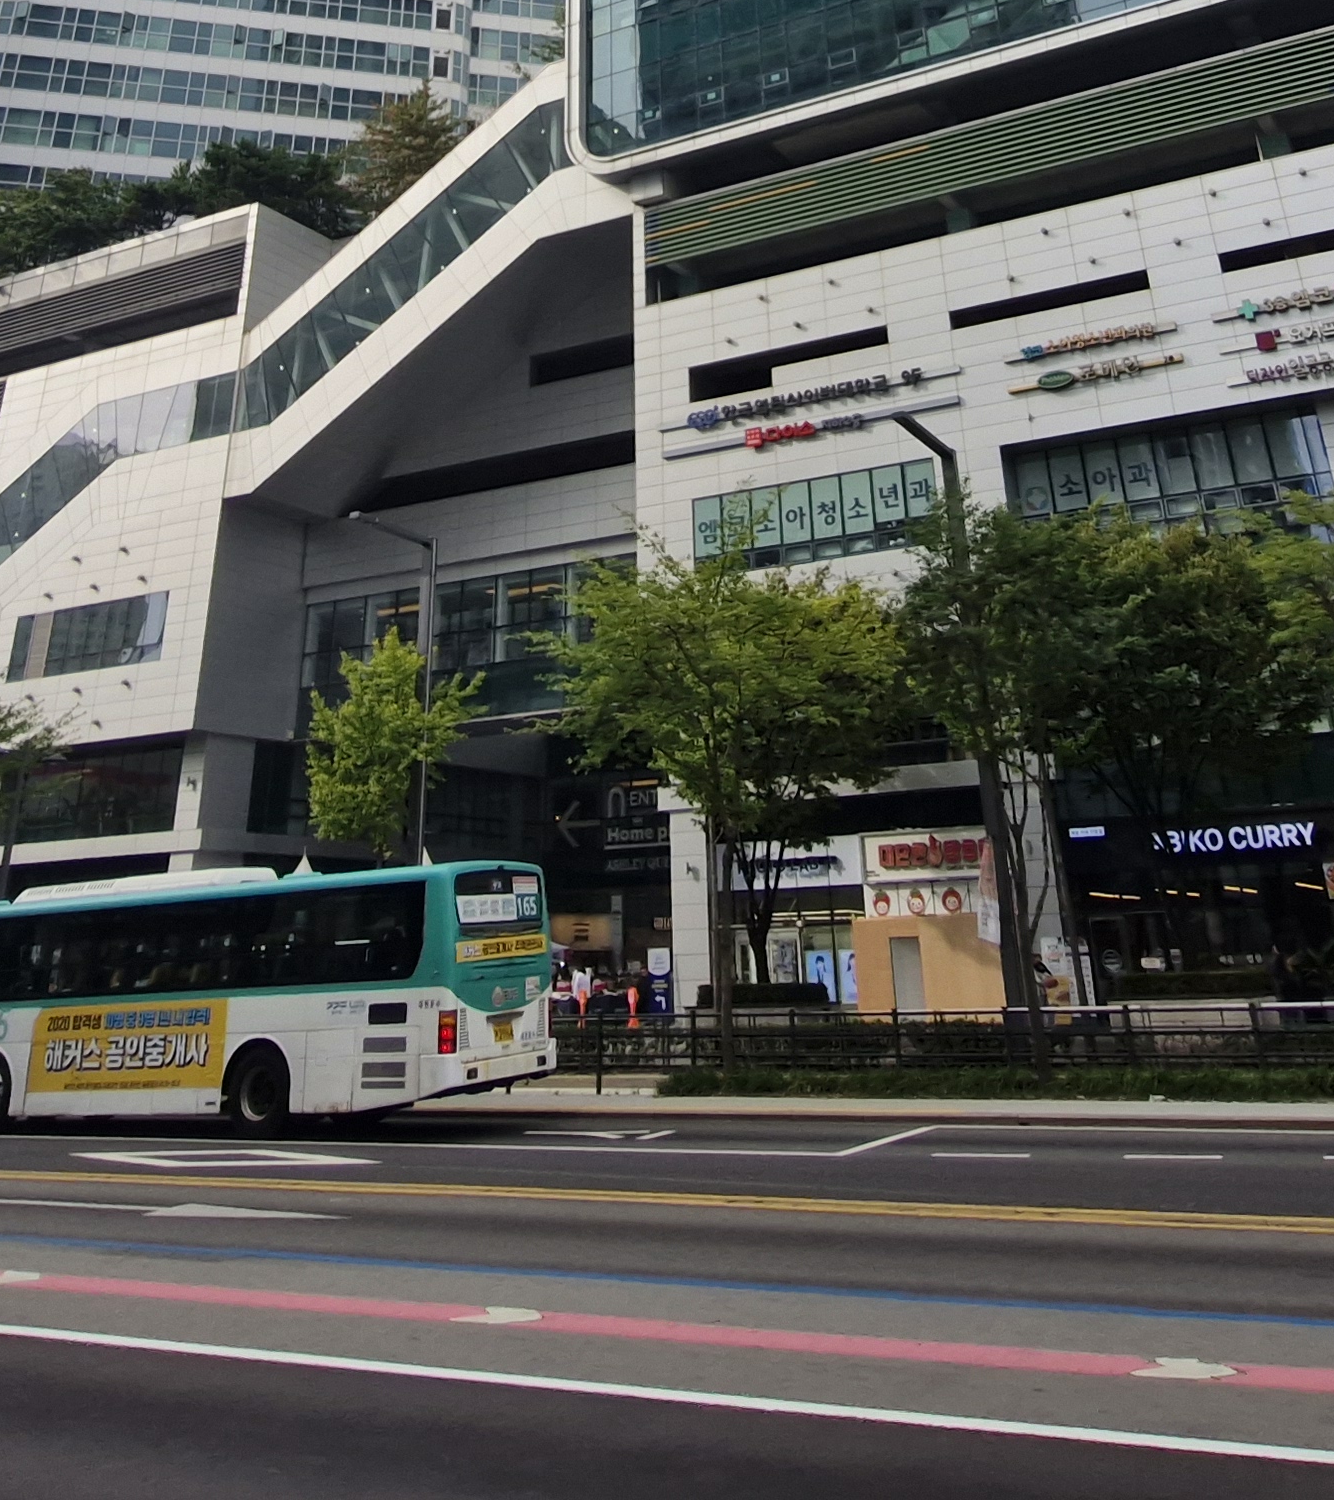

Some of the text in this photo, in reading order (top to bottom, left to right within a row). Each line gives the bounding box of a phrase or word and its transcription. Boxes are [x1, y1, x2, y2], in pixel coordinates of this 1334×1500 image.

[763, 421, 817, 442] 다이소
[1059, 460, 1154, 498] 소아과
[606, 827, 654, 843] Home
[1228, 822, 1314, 850] CURRY
[516, 896, 537, 916] 165
[47, 1016, 71, 1032] 2020
[43, 1032, 209, 1074] 해커스 공인중개사
